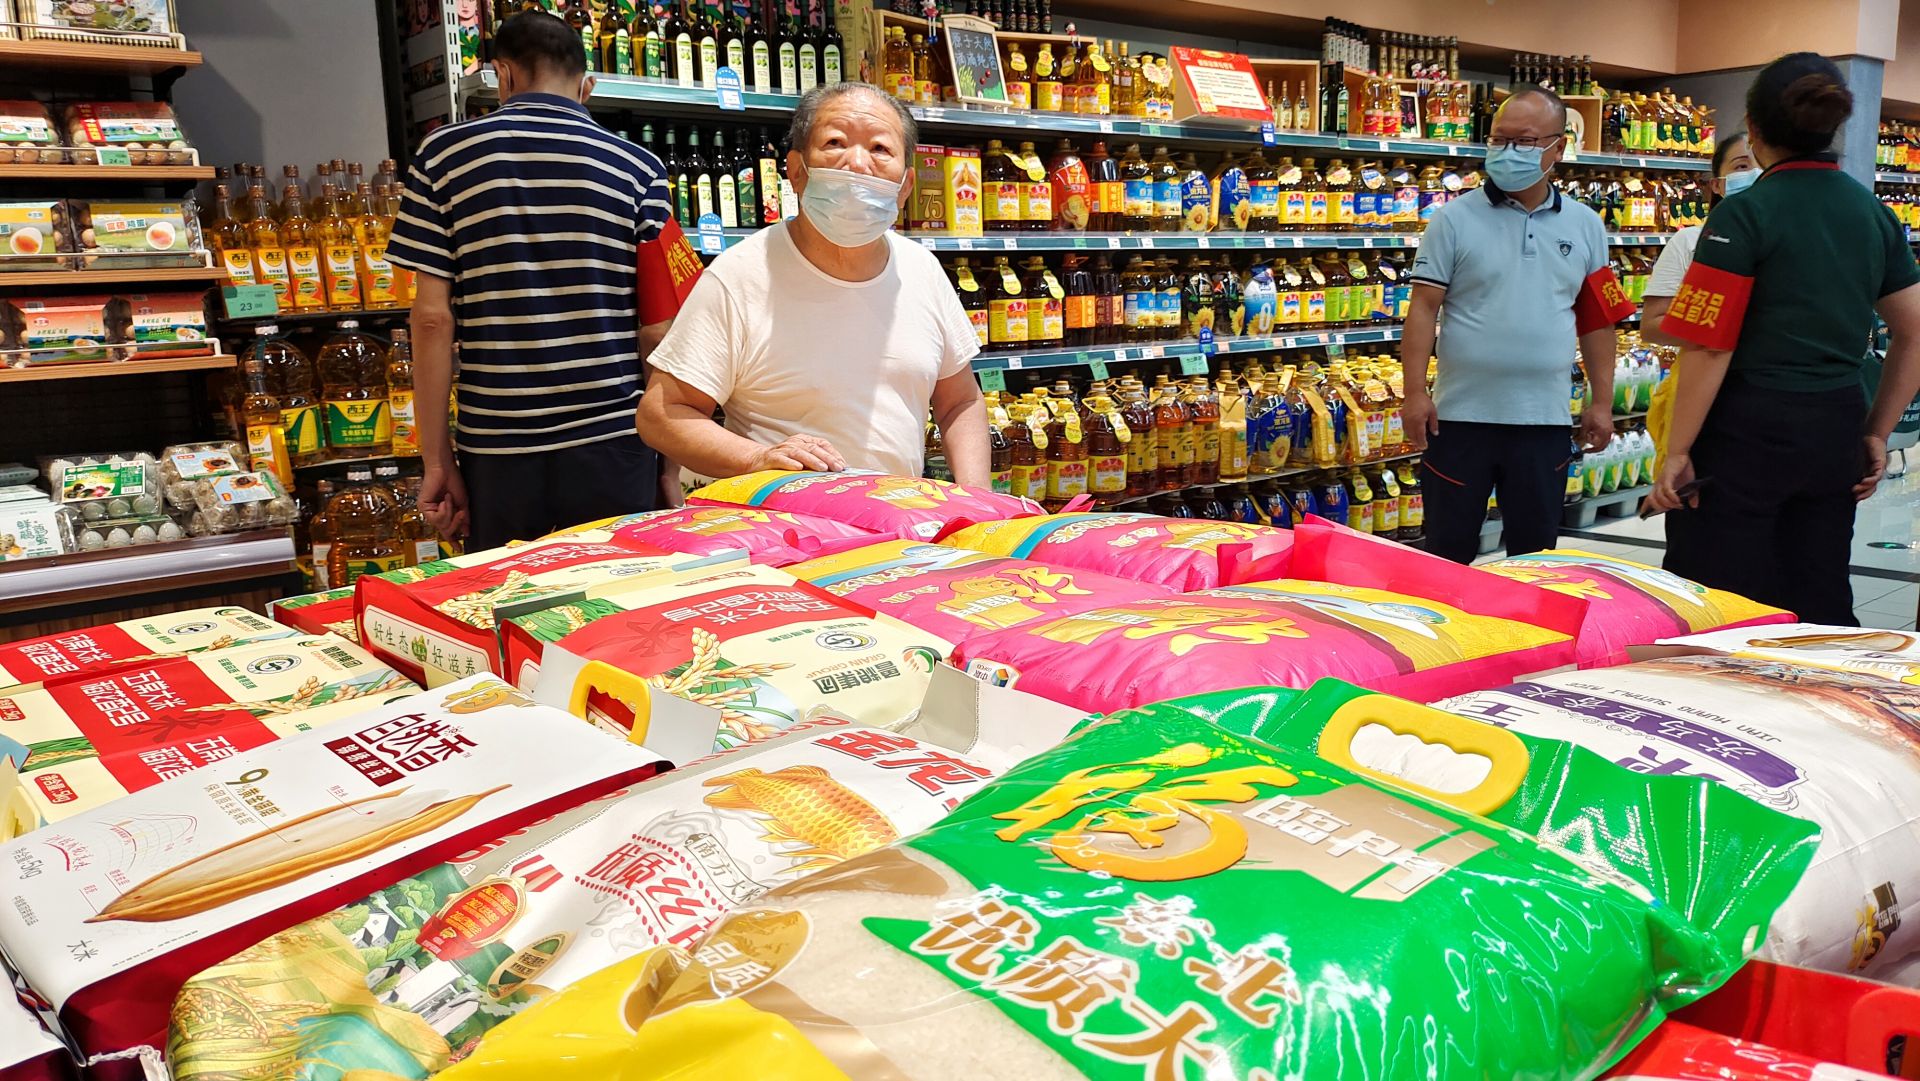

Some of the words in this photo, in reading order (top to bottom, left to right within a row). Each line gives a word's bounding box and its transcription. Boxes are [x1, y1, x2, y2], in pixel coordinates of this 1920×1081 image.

[920, 189, 944, 219] 75
[266, 252, 281, 260] 西王
[295, 252, 311, 260] 西王
[332, 250, 348, 258] 西王
[347, 404, 370, 416] 西王
[707, 600, 836, 625] 五常大米
[55, 633, 113, 664] 五常大米
[374, 621, 409, 654] 好生态
[432, 645, 476, 676] 好滋养
[806, 659, 847, 679] GROUP
[848, 652, 887, 669] GRAIN
[812, 660, 901, 694] 鲁粮集团
[122, 669, 188, 711] 五常大米
[1521, 683, 1760, 762] 苏马里香米
[1736, 724, 1782, 744] JIAN
[354, 712, 479, 772] 自然香
[811, 729, 996, 813] 金龙
[67, 938, 98, 963] 大米
